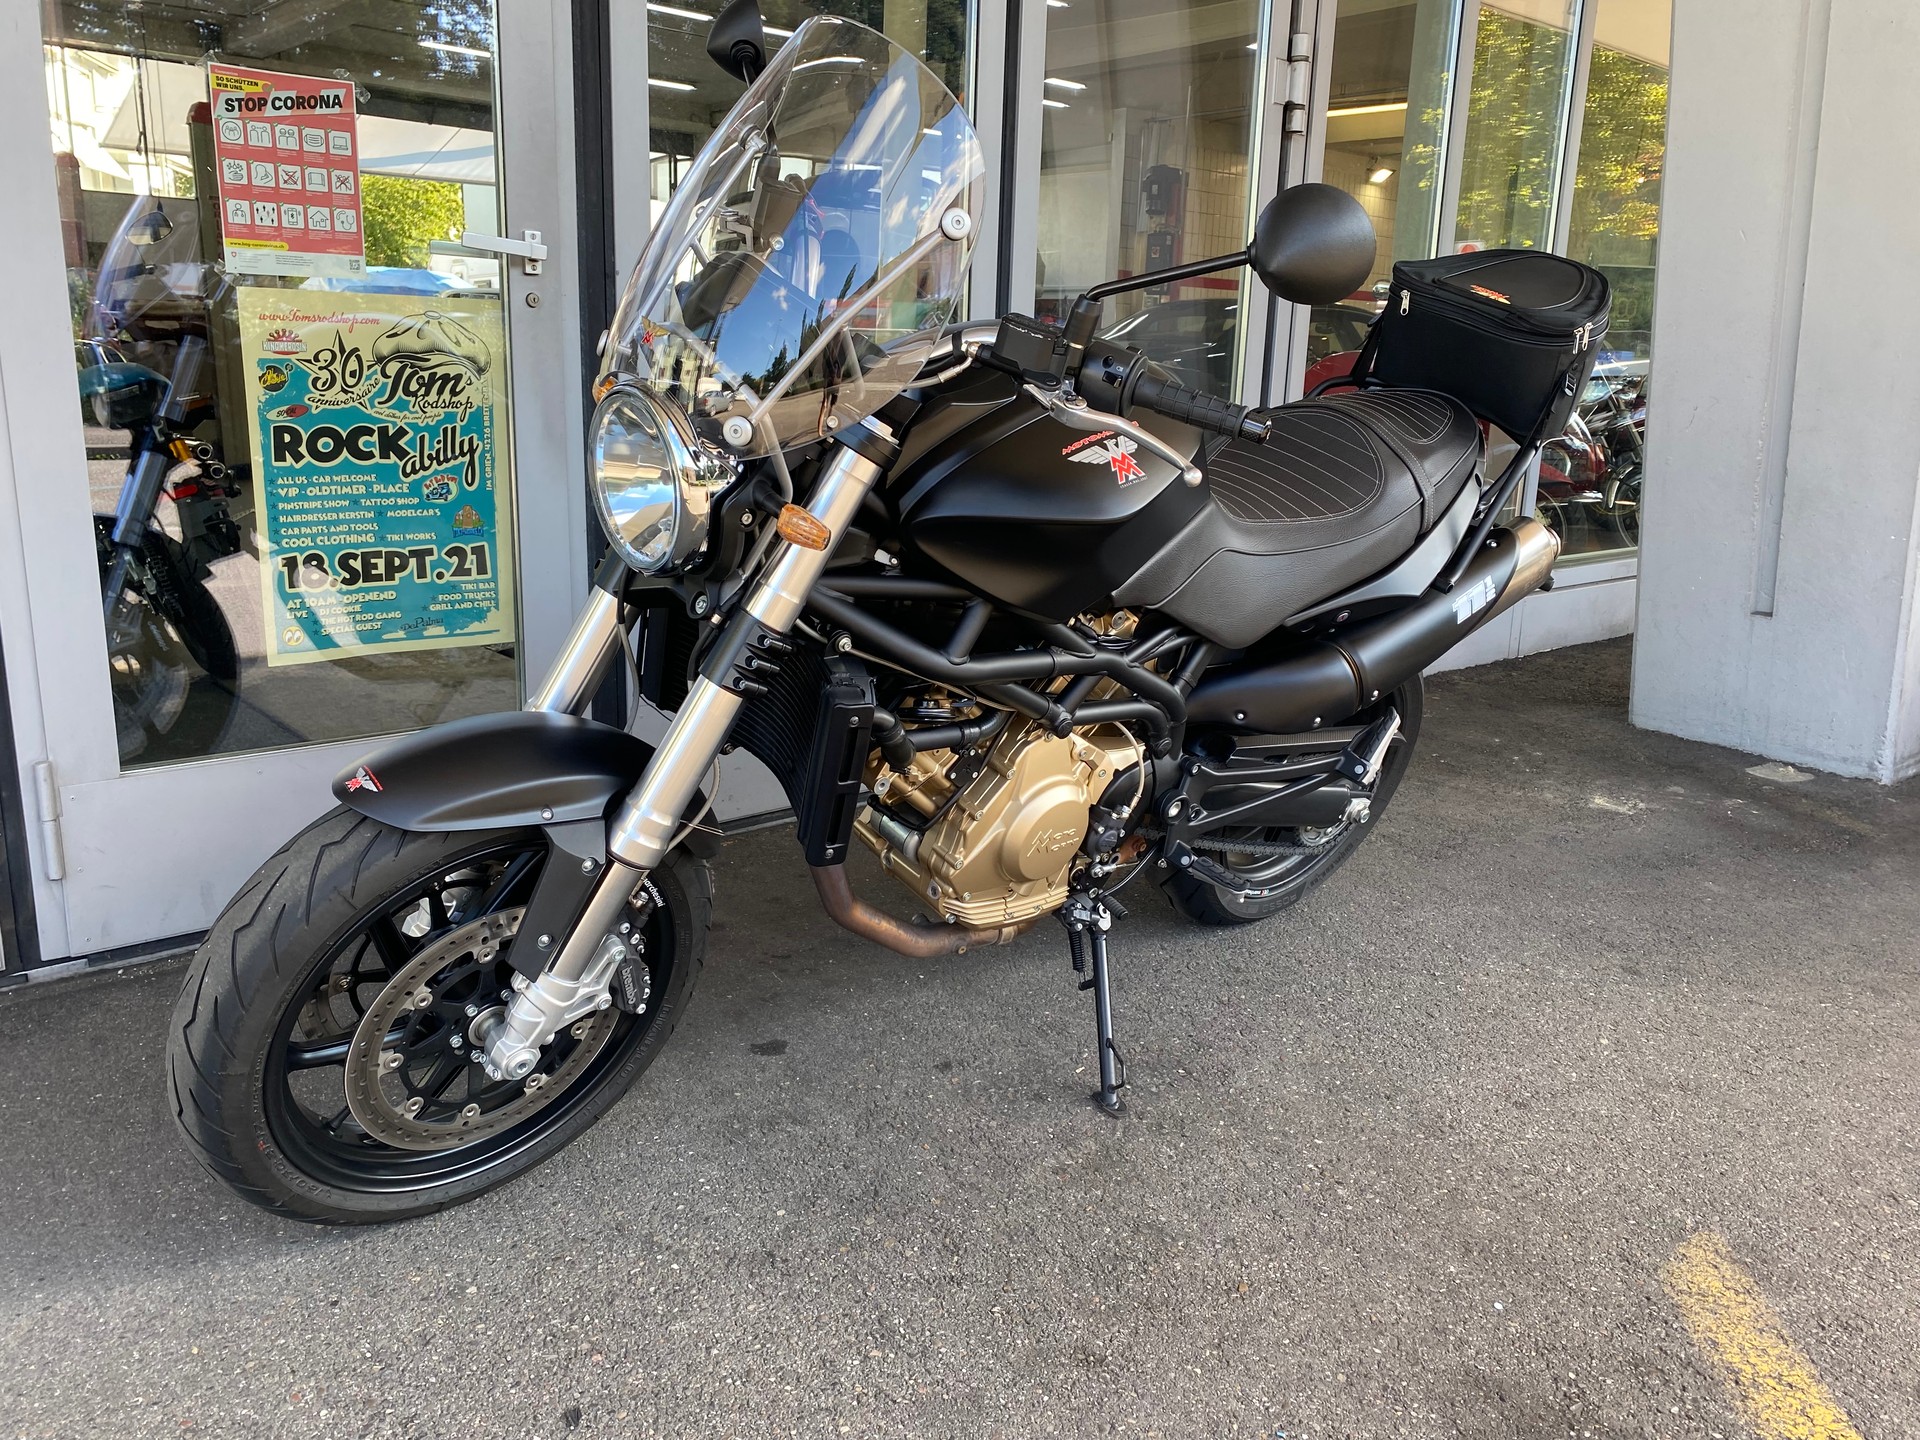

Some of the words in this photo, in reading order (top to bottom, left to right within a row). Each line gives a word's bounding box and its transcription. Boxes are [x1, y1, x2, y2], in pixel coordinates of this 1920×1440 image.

[226, 77, 258, 87] SCHÜTZEN
[224, 97, 267, 113] STOP
[271, 95, 343, 111] CORONA
[311, 347, 364, 394] 30
[412, 393, 475, 422] Rodshop
[483, 427, 492, 450] 4226
[273, 423, 411, 463] ROCK
[401, 425, 481, 486] abilly
[277, 476, 294, 485] ALL
[296, 476, 307, 484] US
[312, 475, 331, 483] CAR
[333, 474, 377, 482] WELCOME
[485, 480, 493, 491] IM
[278, 488, 299, 498] VIP
[306, 485, 366, 496] OLDTIMER
[373, 483, 410, 494] PLACE
[279, 500, 322, 510] PINSTRIPE
[324, 499, 349, 508] SHOW
[361, 497, 395, 507] TATTOO
[396, 496, 420, 505] SHOP
[279, 512, 338, 523] HAIRDRESSER
[339, 510, 375, 520] KERSTIN
[387, 508, 441, 518] MODELCAR'S
[281, 527, 299, 536] CAR
[300, 525, 328, 534] PARTS
[330, 523, 349, 532] AND
[350, 522, 379, 531] TOOLS
[281, 537, 314, 548] COOL
[316, 533, 375, 546] CLOTHING
[386, 533, 404, 542] TIKI
[405, 532, 437, 541] WORKS
[460, 582, 479, 591] TIKI
[287, 599, 302, 610] AT
[343, 590, 397, 604] OPENEND
[438, 592, 462, 601] FOOD
[463, 591, 496, 600] TRUCKS
[320, 607, 329, 616] DJ
[330, 604, 362, 614] COOKIE
[429, 602, 453, 611] GRILL
[454, 601, 473, 609] AND
[475, 599, 496, 608] CHILL
[287, 610, 308, 620] LIVE
[321, 615, 336, 626] THE
[337, 614, 354, 624] HOT
[356, 613, 373, 622] ROD
[375, 610, 402, 621] GANG
[321, 624, 354, 636] SPECIAL
[356, 621, 382, 632] GUEST
[641, 877, 667, 909] archesini
[620, 966, 637, 1006] brembo
